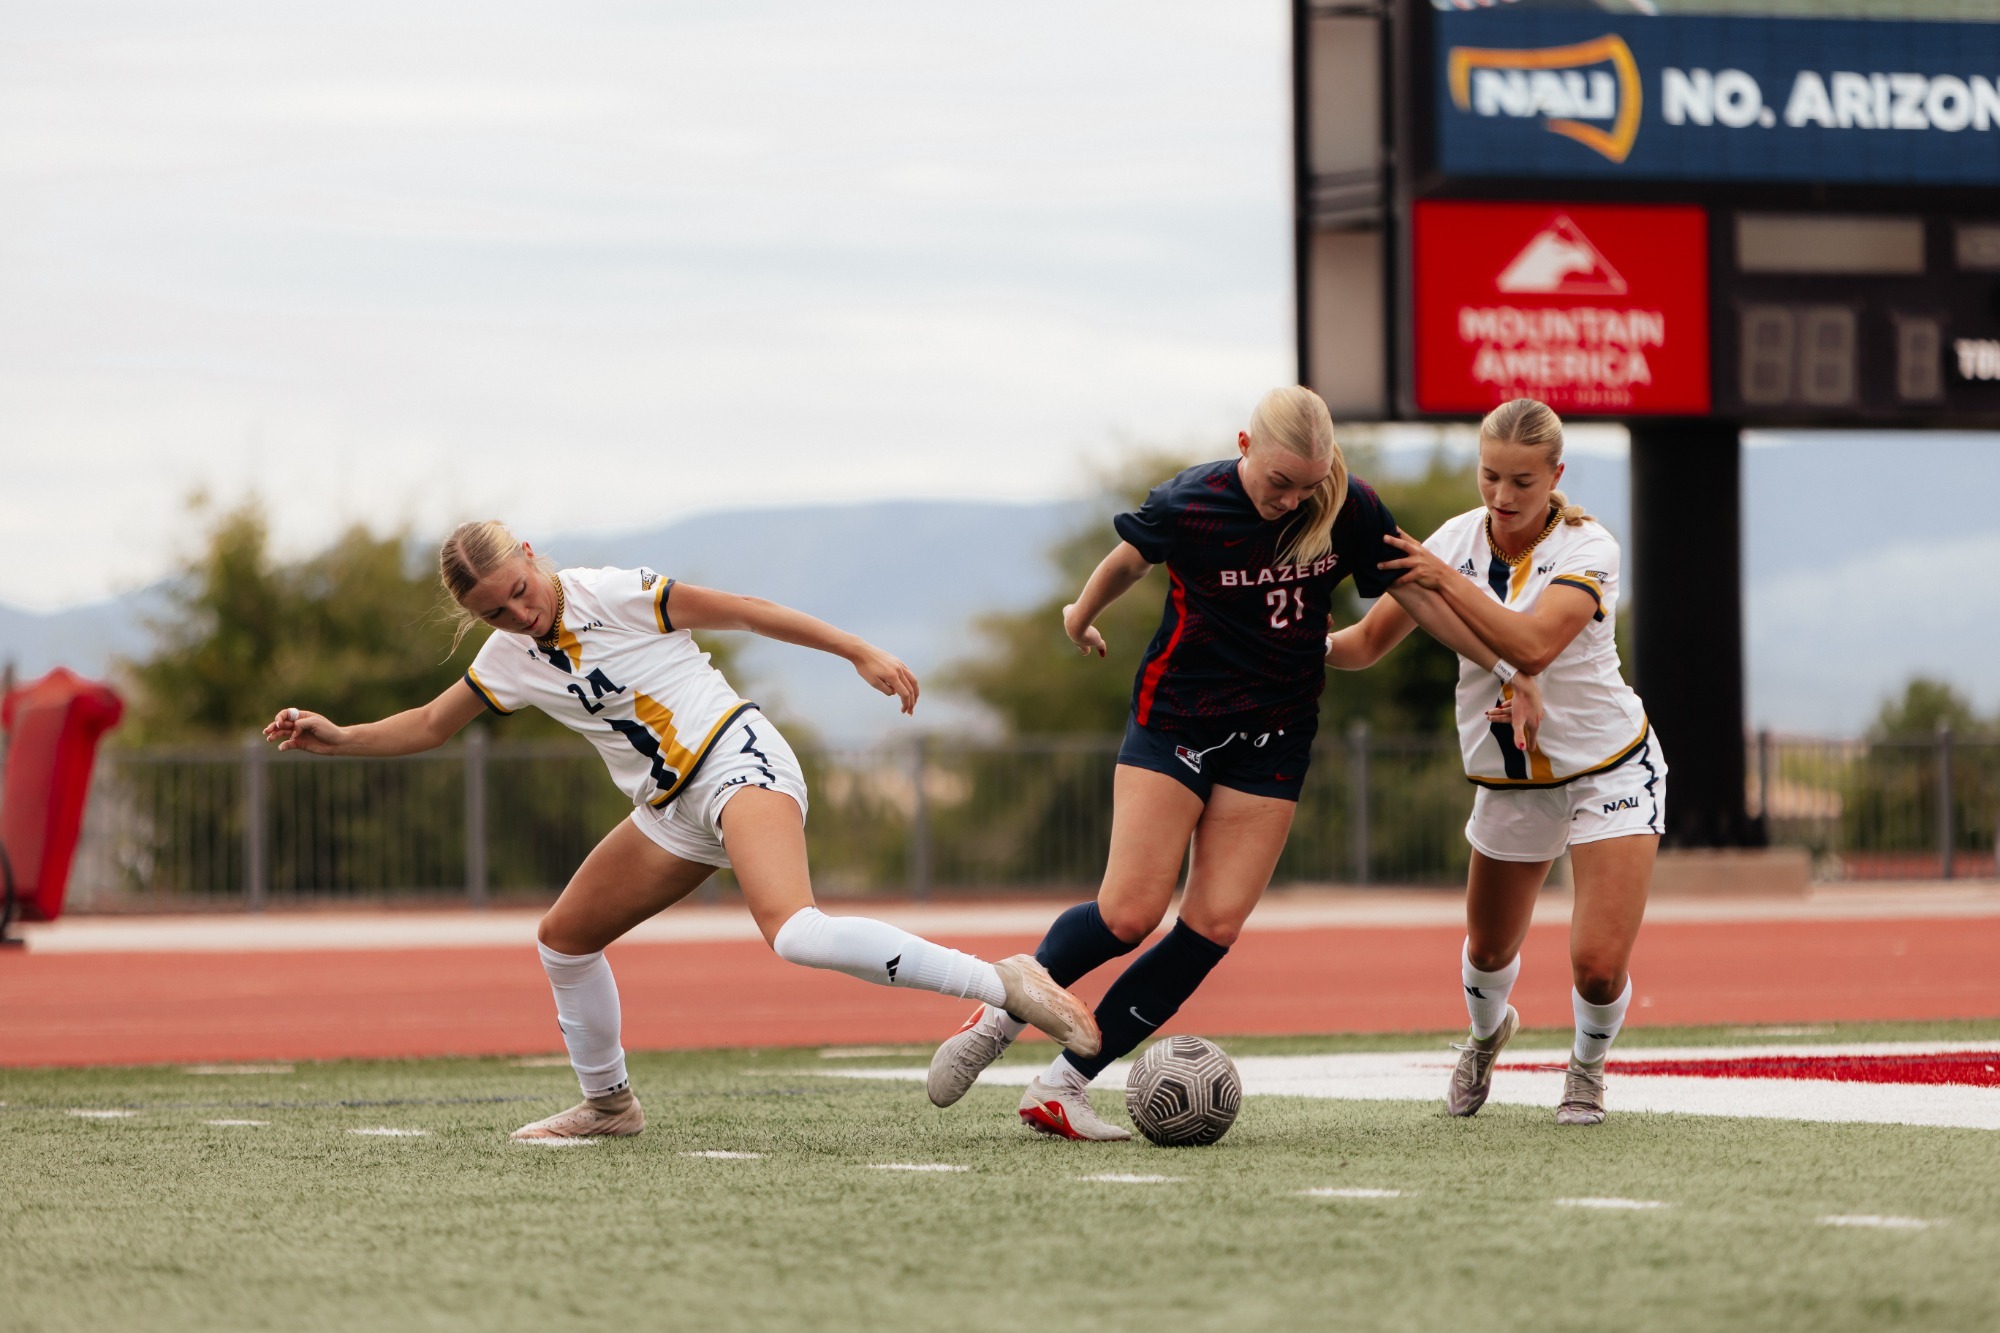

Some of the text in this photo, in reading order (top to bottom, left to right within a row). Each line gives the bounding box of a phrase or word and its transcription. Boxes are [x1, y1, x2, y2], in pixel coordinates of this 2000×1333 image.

[1474, 69, 1616, 119] NAU
[1661, 67, 1776, 128] NO.
[1459, 307, 1665, 347] MOUNTAIN
[1473, 346, 1651, 387] AMERICA
[1220, 553, 1339, 586] BLAZERS
[1267, 586, 1304, 629] 21
[567, 667, 627, 715] 24
[1603, 796, 1639, 813] NAU
